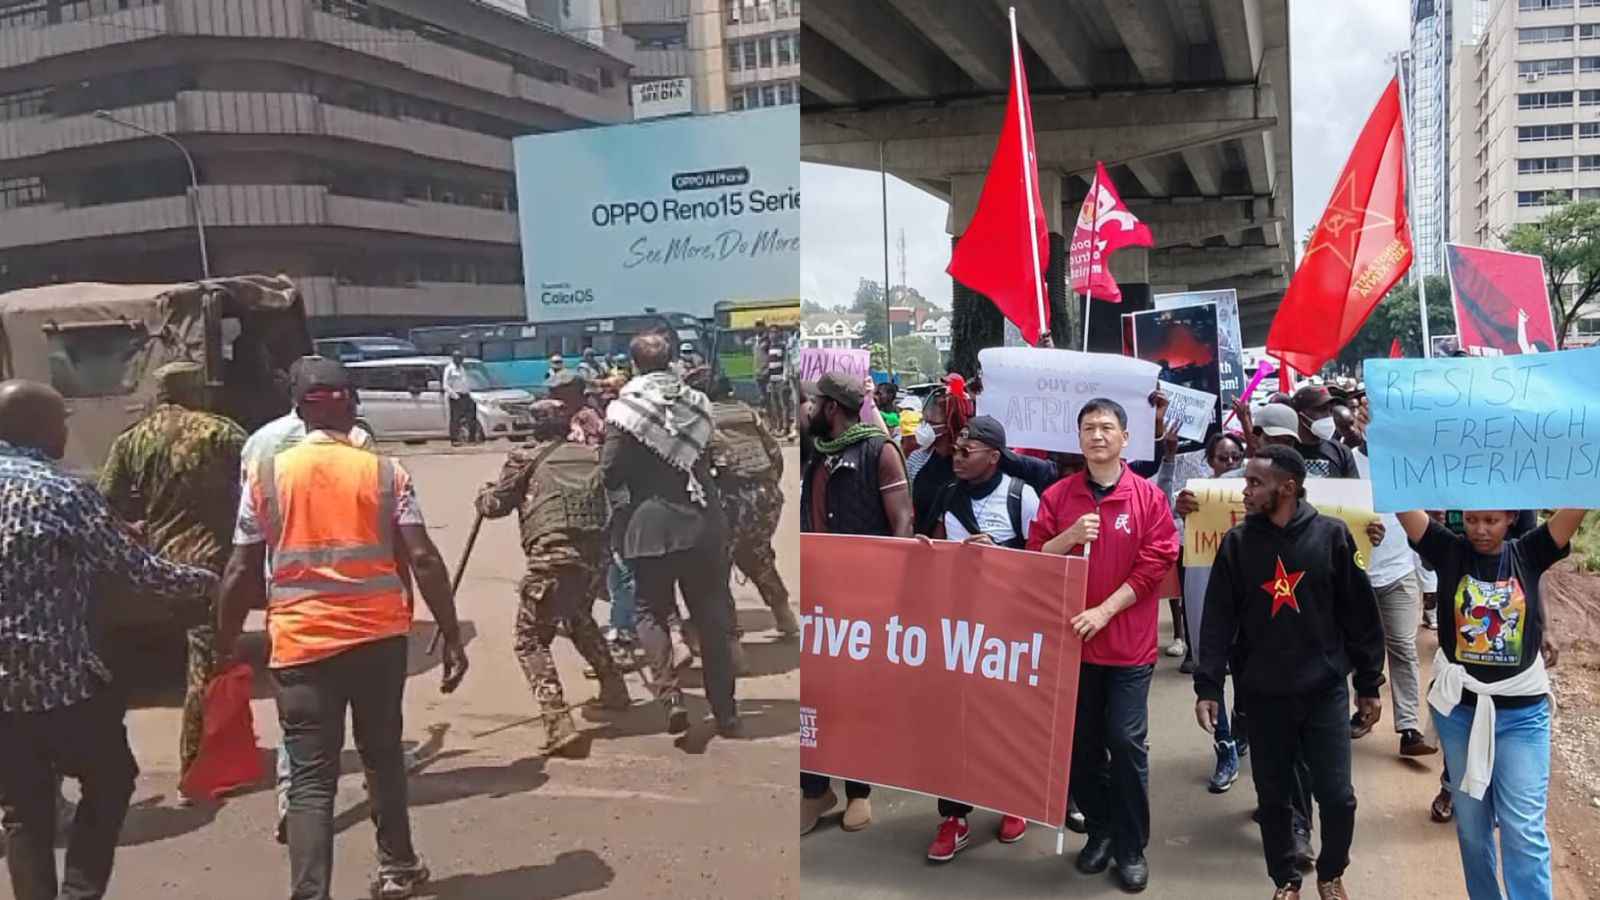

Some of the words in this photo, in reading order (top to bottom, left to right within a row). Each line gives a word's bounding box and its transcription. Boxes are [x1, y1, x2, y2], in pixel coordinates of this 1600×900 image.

[676, 176, 703, 187] OPPO
[705, 174, 715, 185] AI
[716, 171, 745, 184] Phone
[592, 201, 658, 227] OPPO
[663, 191, 744, 222] Reno15
[624, 236, 661, 268] See
[714, 229, 746, 261] Do
[751, 228, 800, 257] More
[541, 288, 594, 305] ColorOS
[1037, 378, 1070, 393] OUT
[1074, 382, 1101, 395] OF
[1385, 362, 1549, 411] RESIST
[1433, 405, 1587, 449] FRENCH
[1115, 513, 1131, 534] 民
[885, 615, 927, 667] to
[941, 617, 1043, 686] War!
